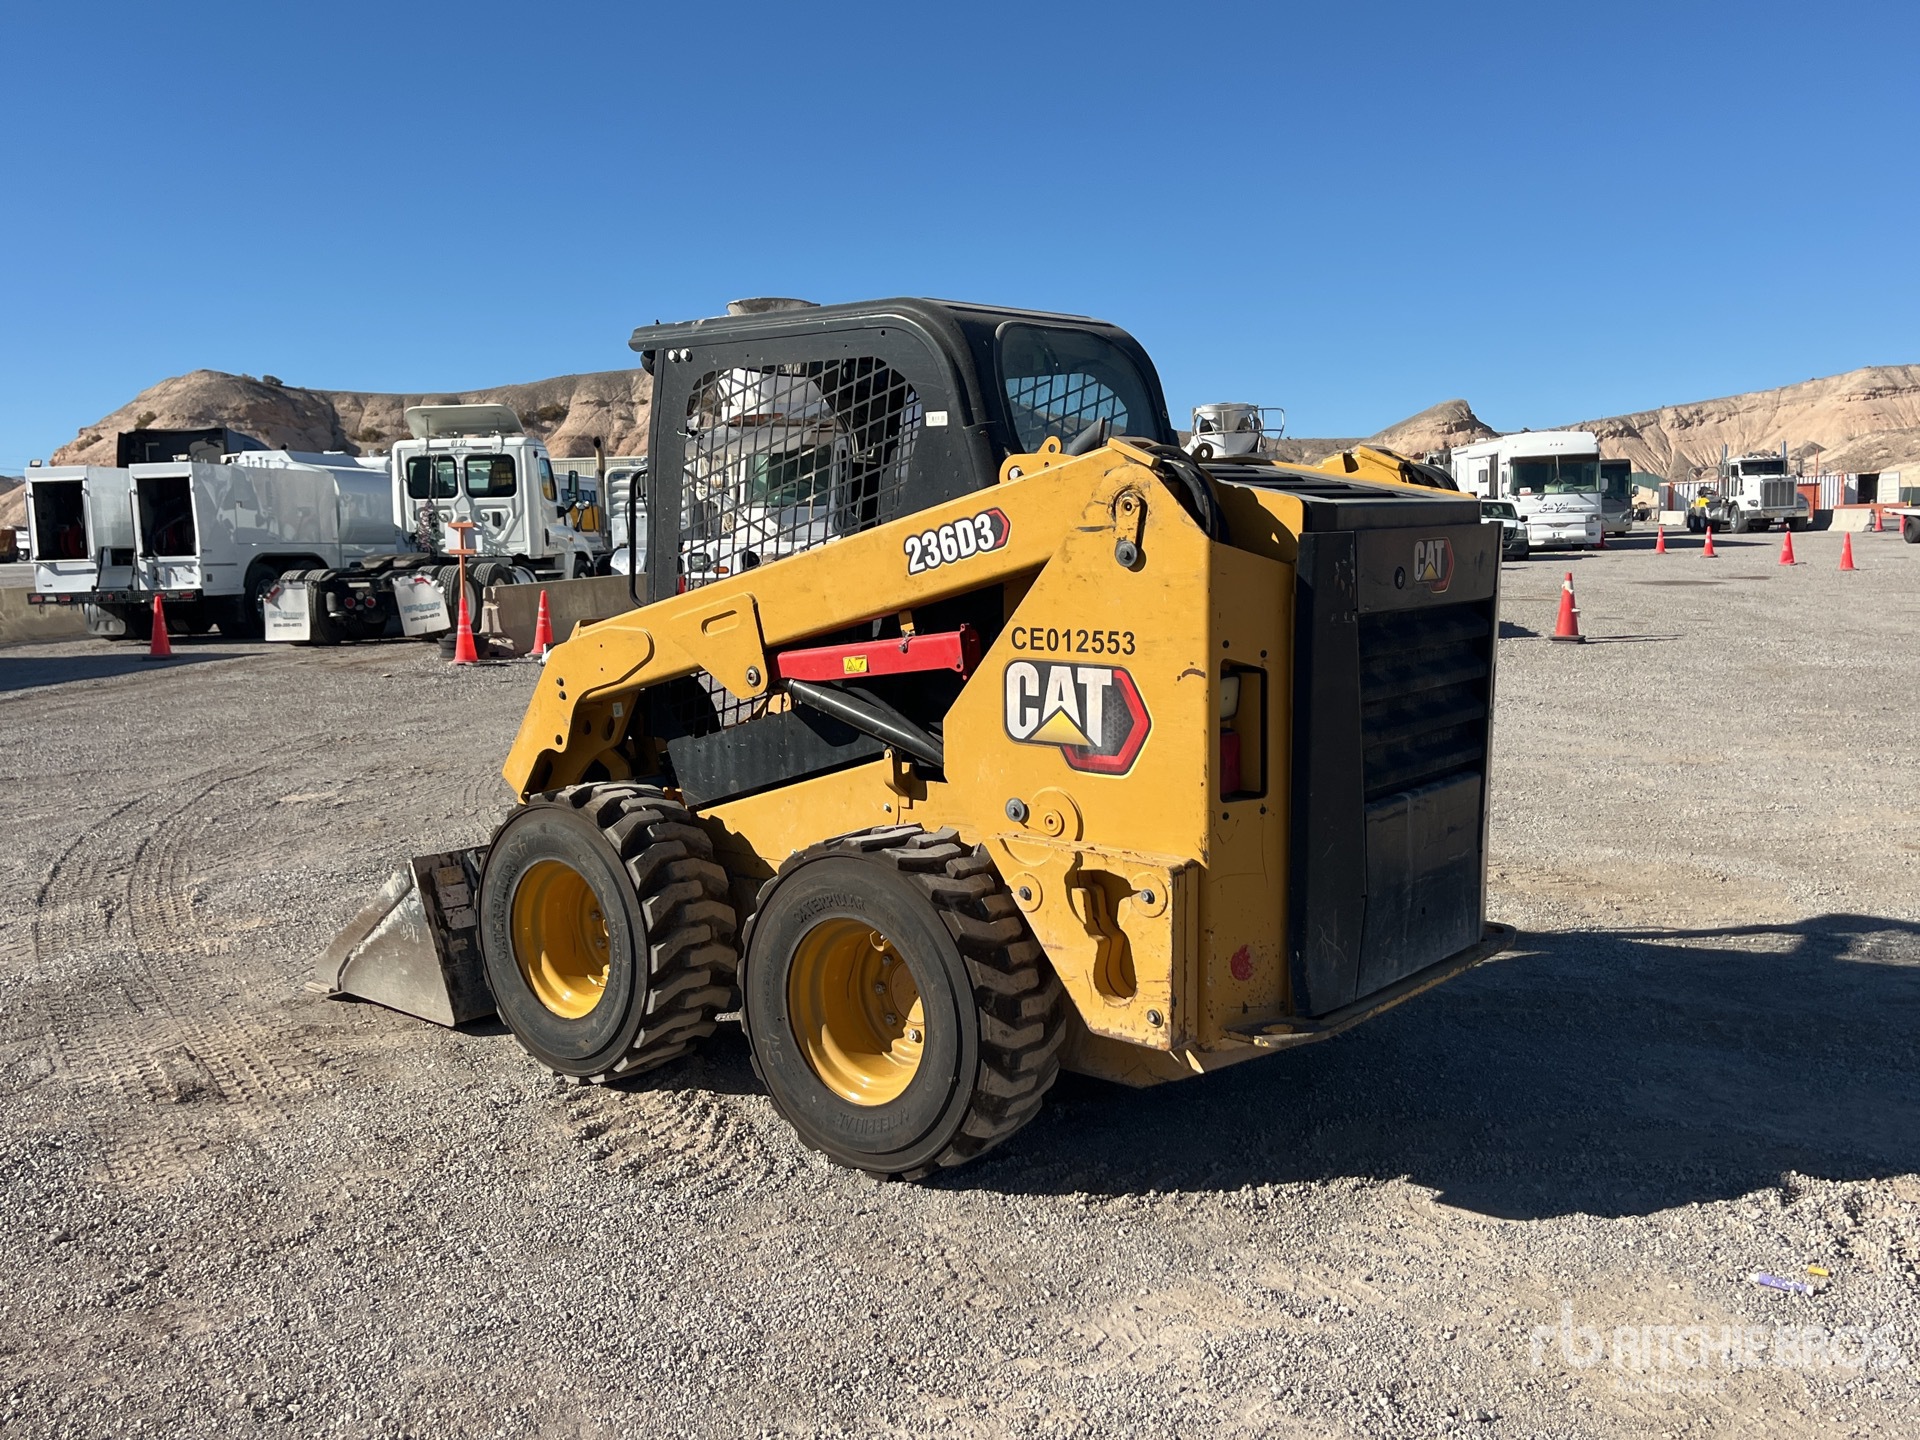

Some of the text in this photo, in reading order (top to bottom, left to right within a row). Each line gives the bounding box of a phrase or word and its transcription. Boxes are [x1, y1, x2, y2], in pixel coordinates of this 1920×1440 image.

[904, 513, 995, 574] 236D3
[1413, 540, 1445, 581] CAT
[1011, 626, 1136, 656] CE012553
[1006, 661, 1113, 748] CAT
[793, 892, 867, 924] CATERPILLAR
